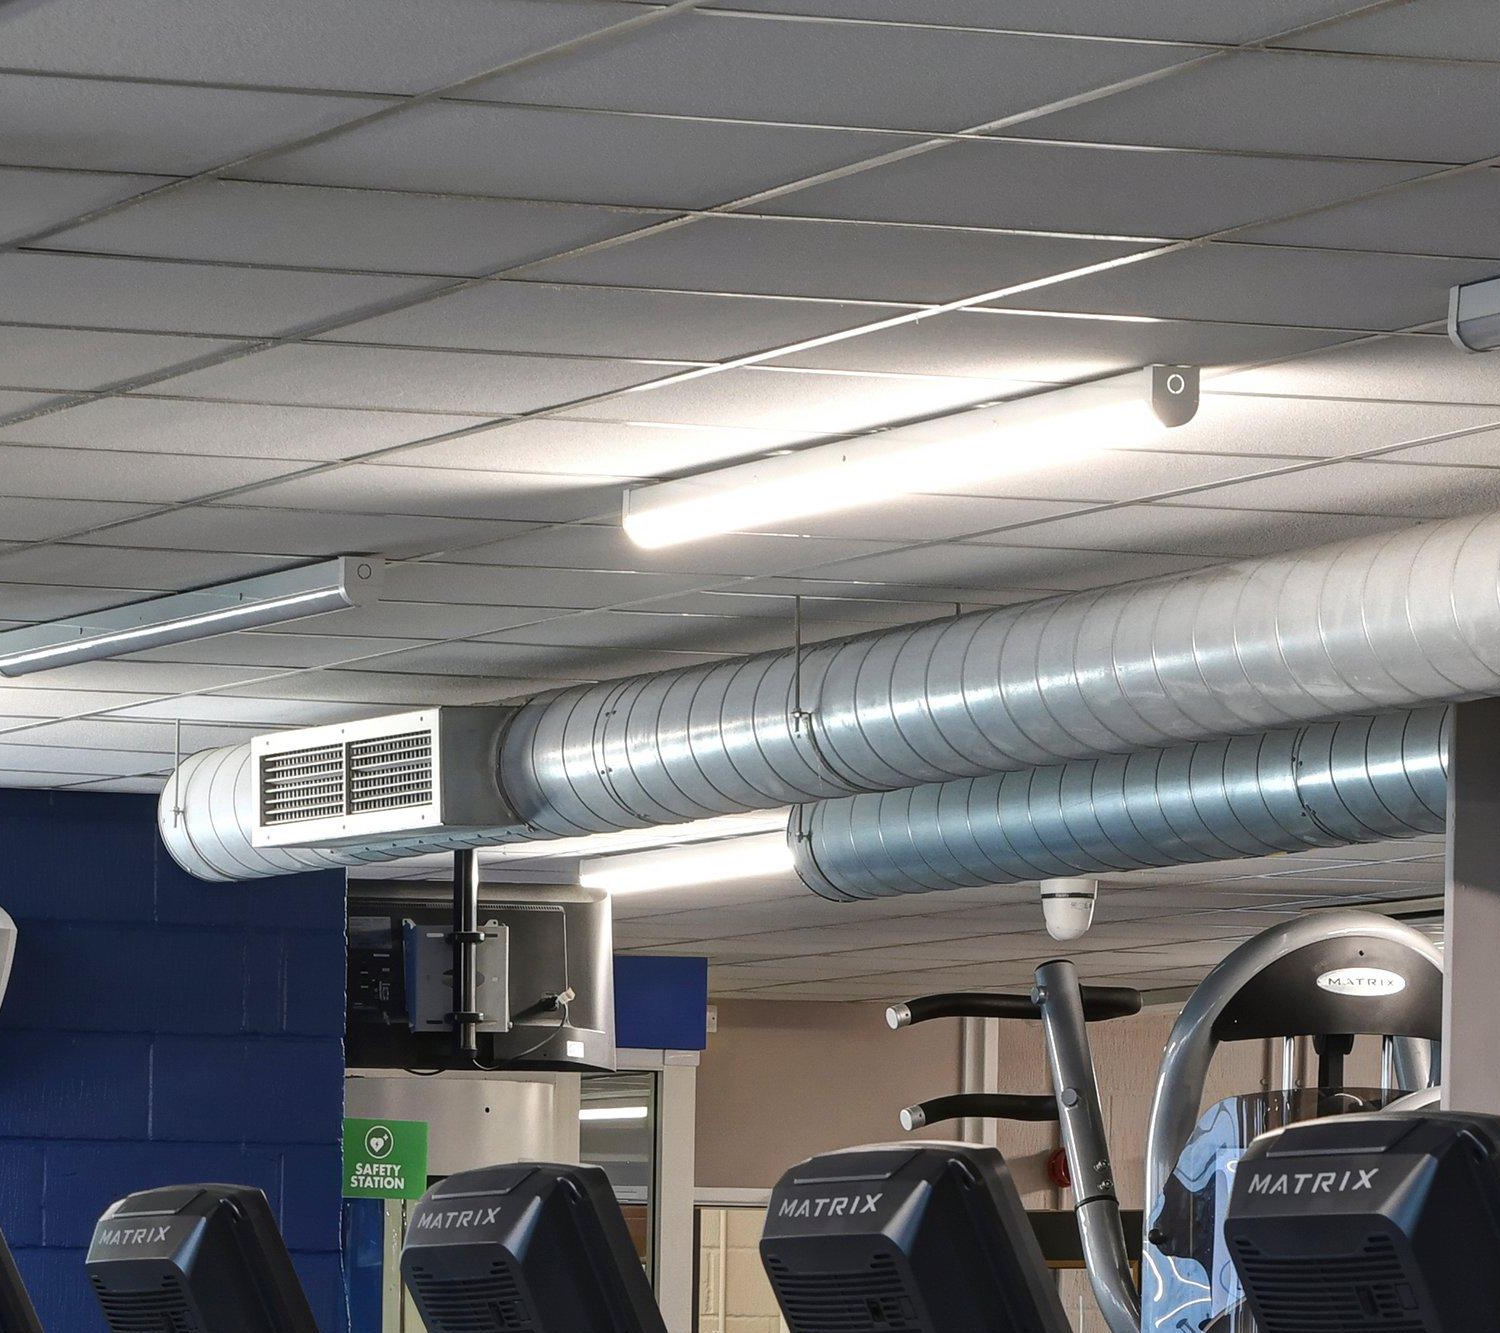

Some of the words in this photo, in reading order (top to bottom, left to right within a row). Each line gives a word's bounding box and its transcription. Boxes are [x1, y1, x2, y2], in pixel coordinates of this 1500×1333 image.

[1328, 977, 1394, 986] MATRIX
[355, 1162, 402, 1177] SAFETY
[350, 1175, 405, 1190] STATION
[1247, 1167, 1380, 1195] MATRIX
[778, 1192, 884, 1218] MATRIX
[417, 1206, 502, 1230] MATRIX
[98, 1225, 172, 1245] MATRIX
